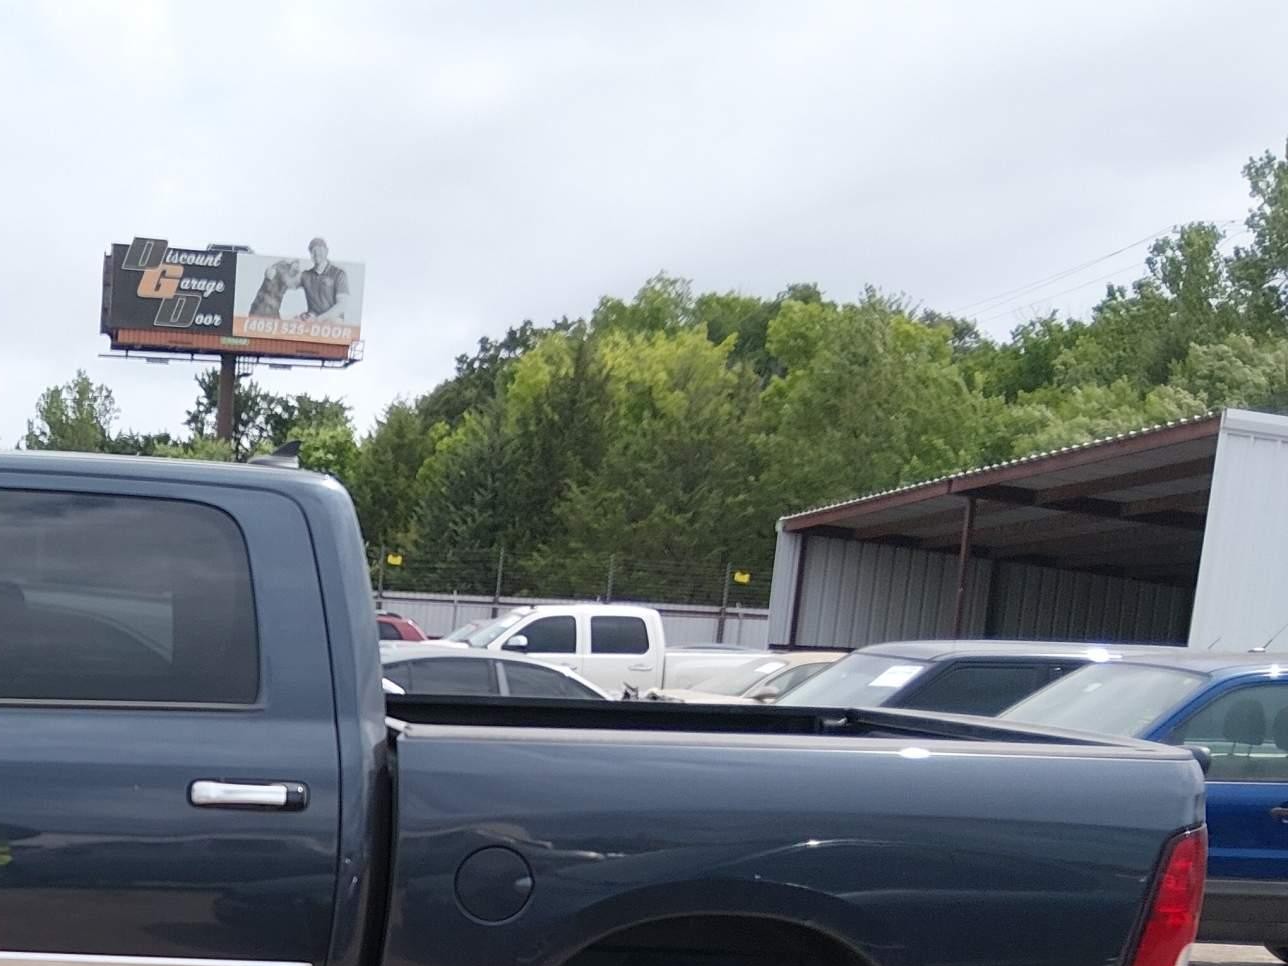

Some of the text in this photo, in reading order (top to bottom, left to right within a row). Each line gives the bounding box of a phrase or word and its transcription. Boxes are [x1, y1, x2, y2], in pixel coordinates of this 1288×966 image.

[121, 236, 224, 272] Discount
[137, 264, 225, 299] Garage
[153, 293, 223, 328] Door
